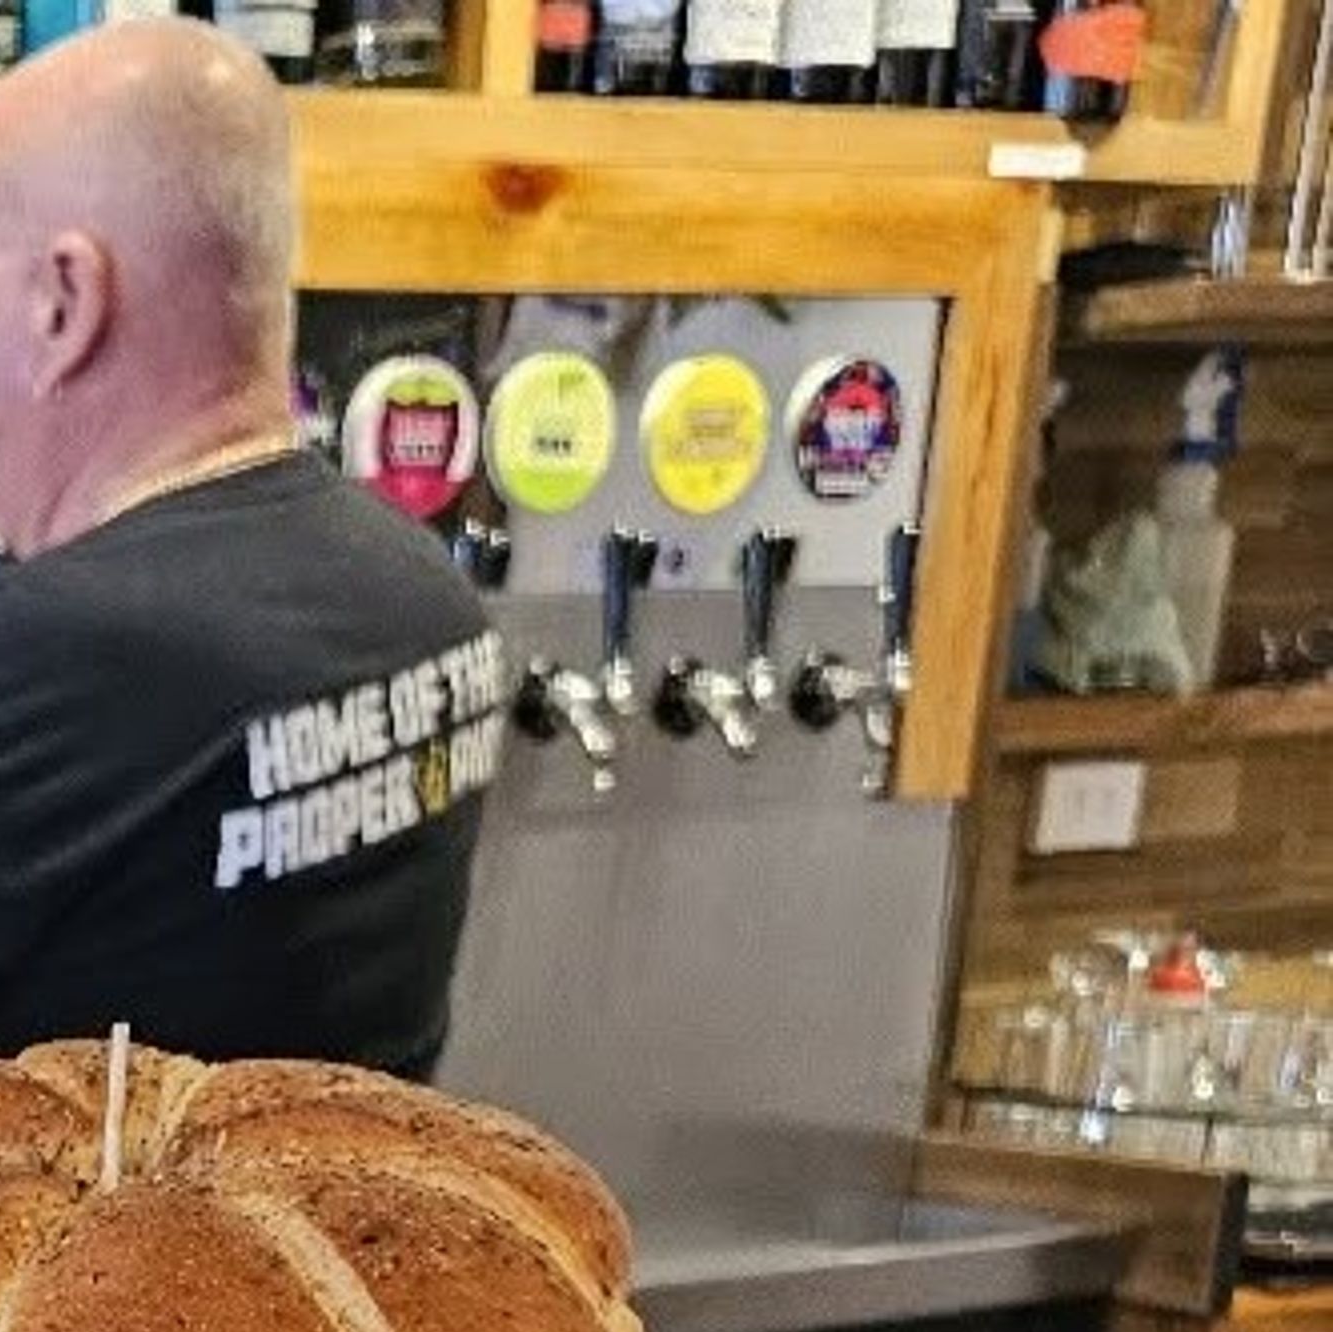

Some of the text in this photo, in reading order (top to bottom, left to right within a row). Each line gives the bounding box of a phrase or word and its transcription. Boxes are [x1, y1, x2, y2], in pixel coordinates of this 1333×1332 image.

[245, 680, 392, 800] HOME
[389, 658, 447, 747] OF
[213, 754, 421, 889] PROPER
